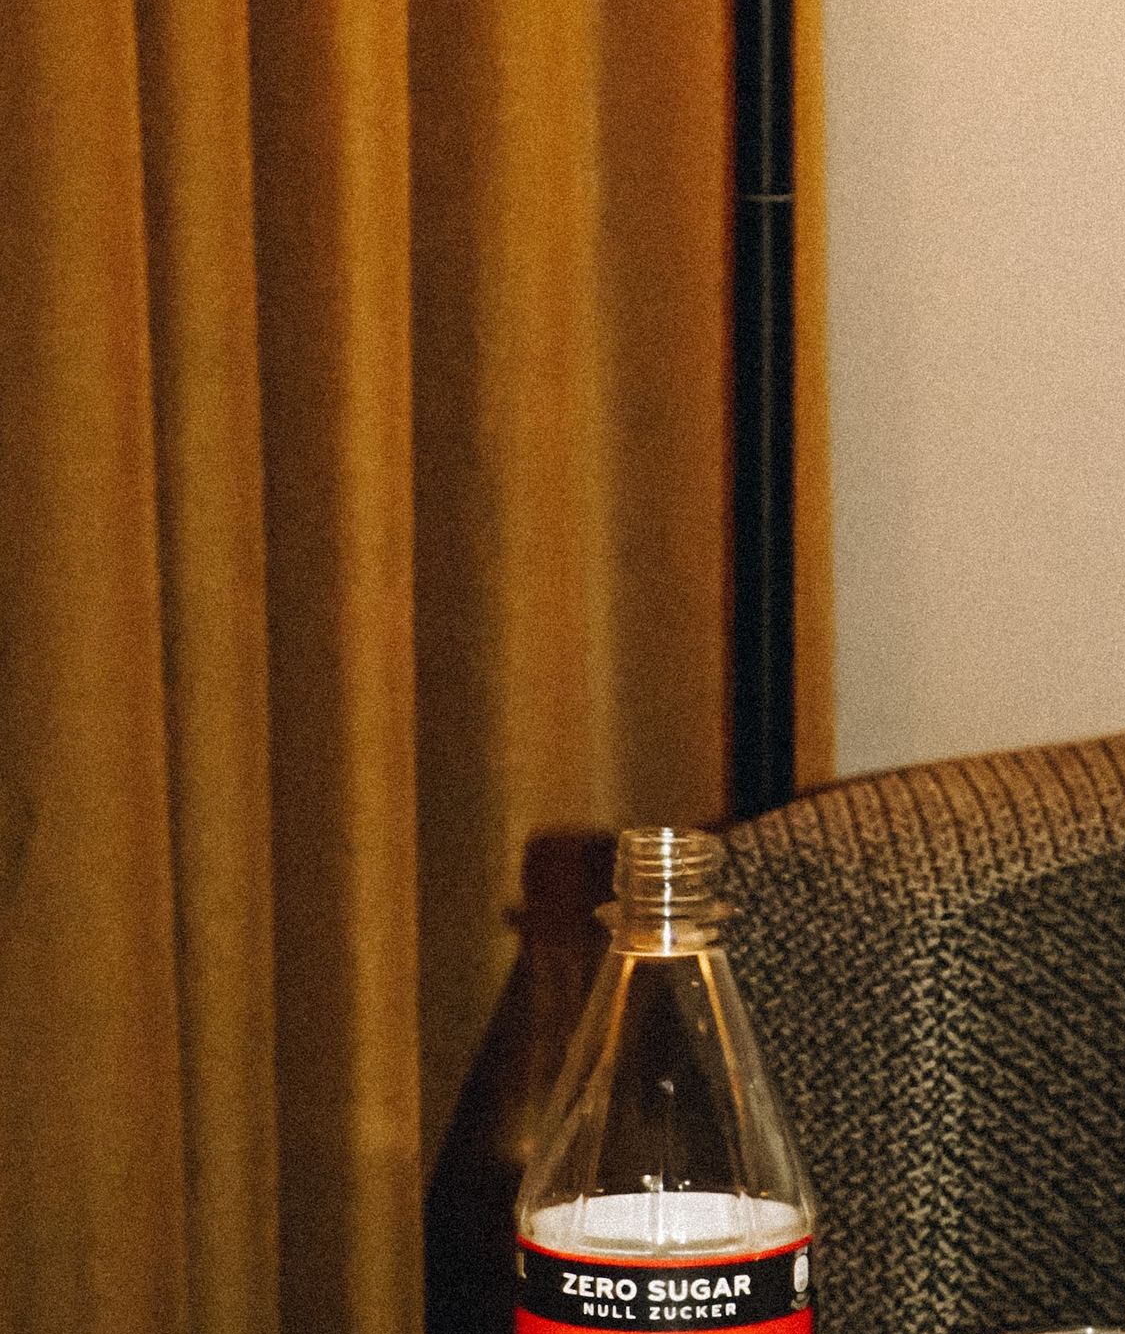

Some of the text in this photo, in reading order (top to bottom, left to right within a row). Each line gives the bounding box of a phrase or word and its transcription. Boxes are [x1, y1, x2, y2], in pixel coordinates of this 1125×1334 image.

[562, 1272, 751, 1302] ZERO SUGAR
[583, 1301, 737, 1320] NULL ZUCKER
